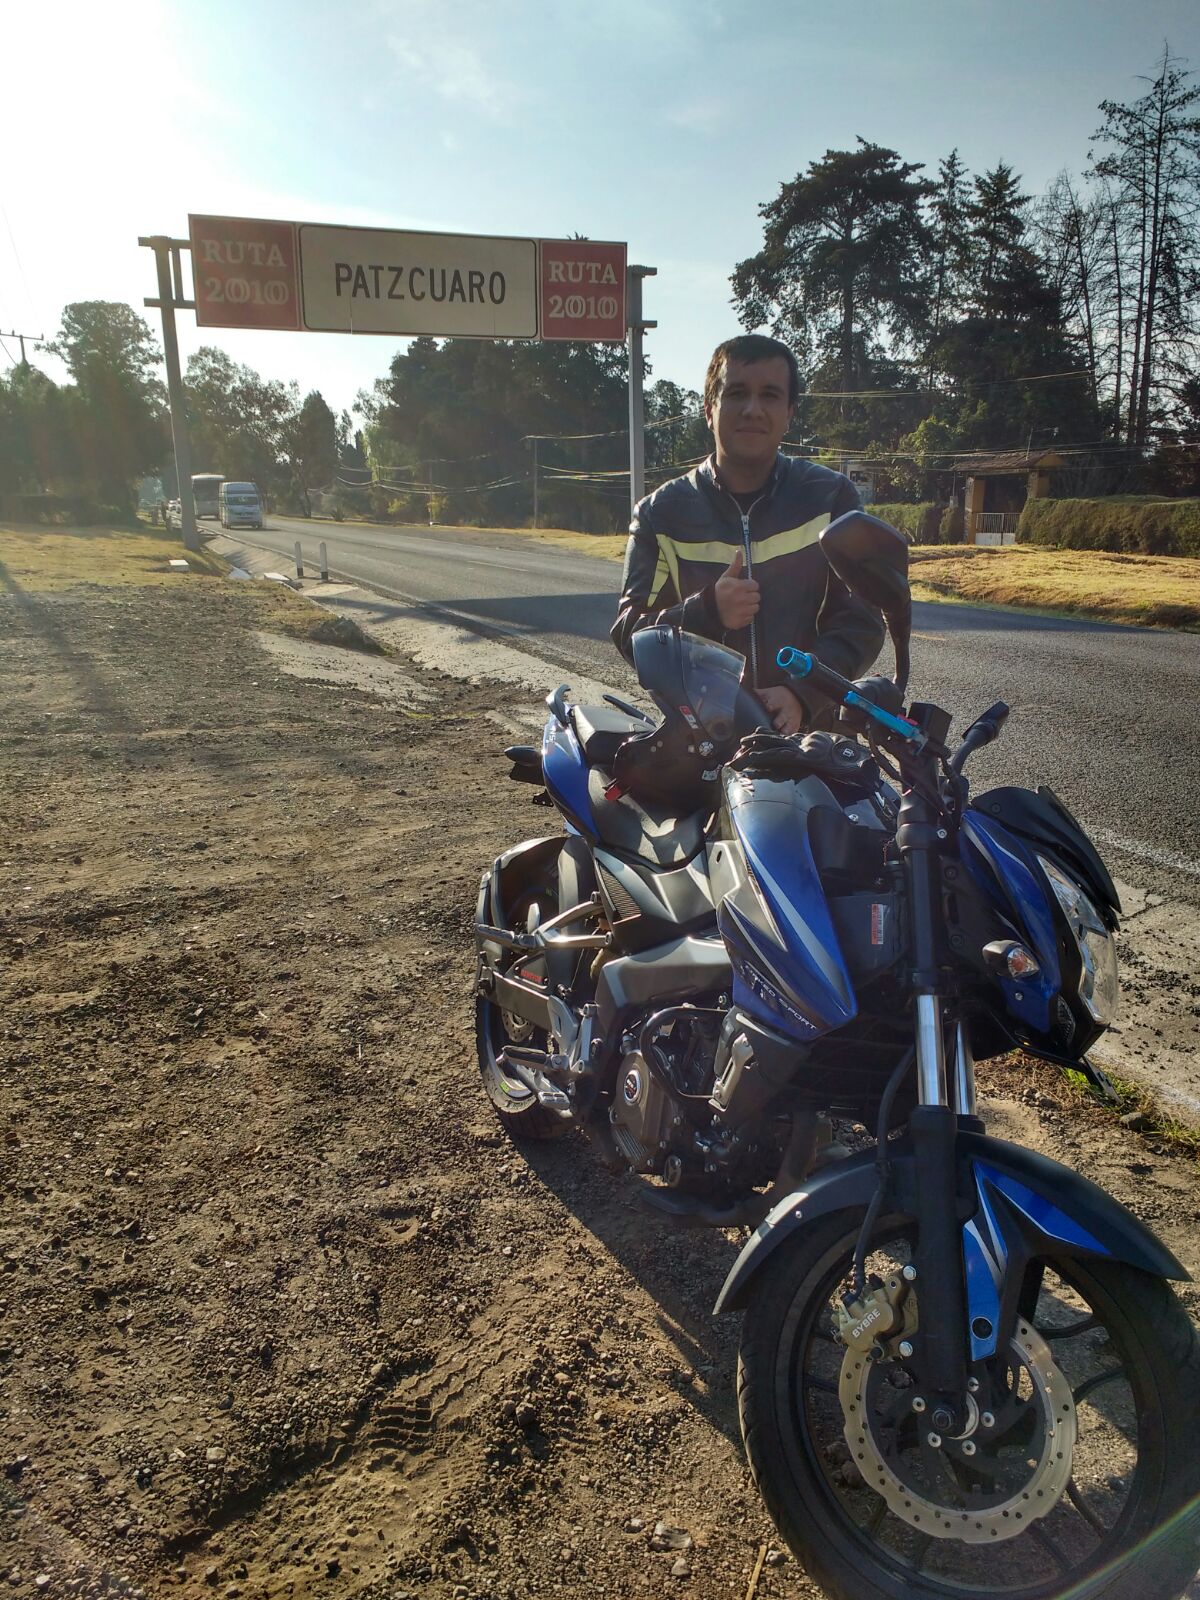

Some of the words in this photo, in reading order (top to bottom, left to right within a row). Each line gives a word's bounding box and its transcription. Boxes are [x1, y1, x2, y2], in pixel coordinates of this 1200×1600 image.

[203, 238, 287, 270] RUTA
[335, 262, 507, 304] PATZCUARO
[548, 260, 618, 285] RUTA
[205, 276, 290, 306] 2010
[548, 295, 618, 320] 2010
[852, 1309, 881, 1337] BYBRE
